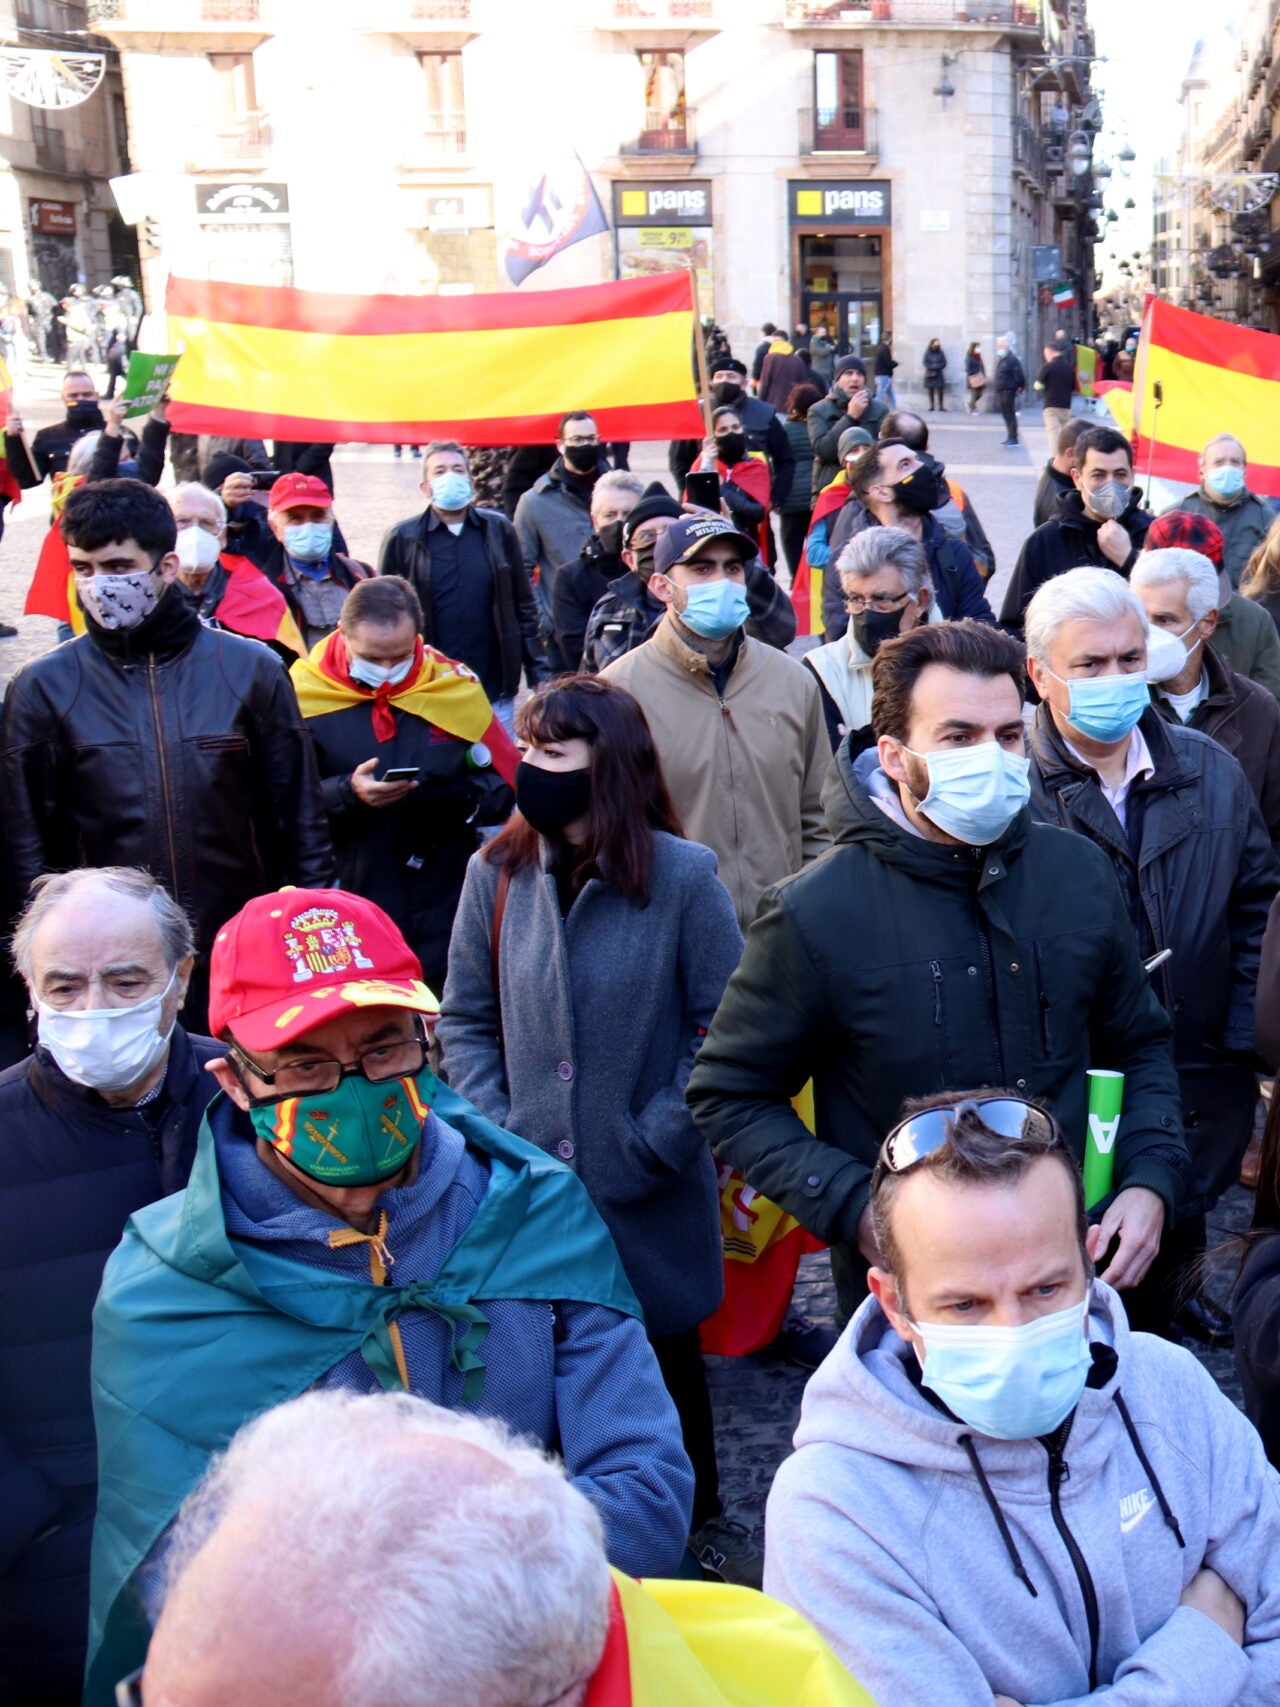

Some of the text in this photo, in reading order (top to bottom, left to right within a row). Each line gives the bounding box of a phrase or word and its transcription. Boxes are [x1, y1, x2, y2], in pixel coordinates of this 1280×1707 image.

[649, 190, 706, 215] pans
[825, 190, 883, 215] pans
[1120, 1488, 1148, 1519] NIKE
[700, 1545, 727, 1570] N
